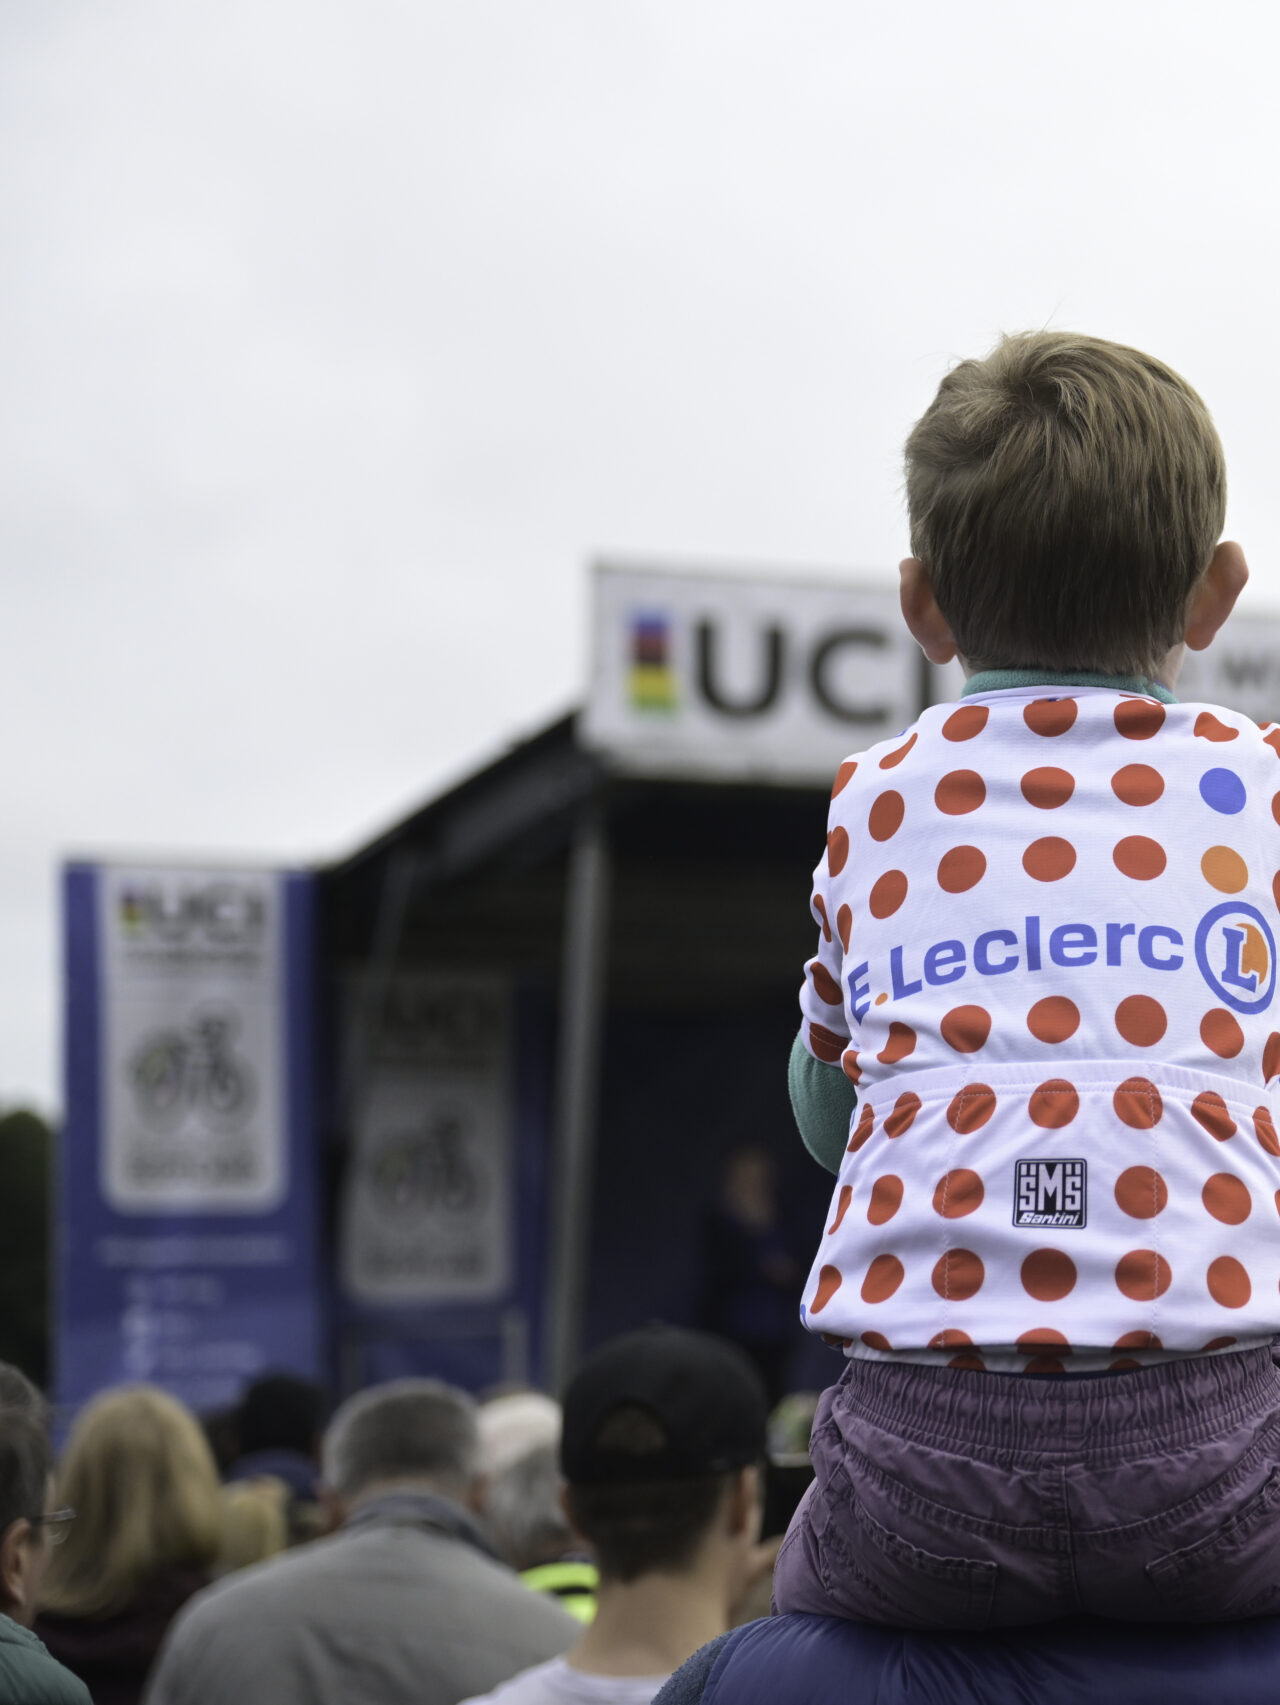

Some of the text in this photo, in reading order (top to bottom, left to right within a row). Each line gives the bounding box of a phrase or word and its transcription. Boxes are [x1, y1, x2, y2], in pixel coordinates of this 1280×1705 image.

[692, 614, 936, 724] UCI
[146, 880, 266, 944] UCI
[847, 916, 1184, 1026] E.Leclerc
[1018, 1211, 1080, 1225] Santini
[1019, 1162, 1082, 1211] SMS
